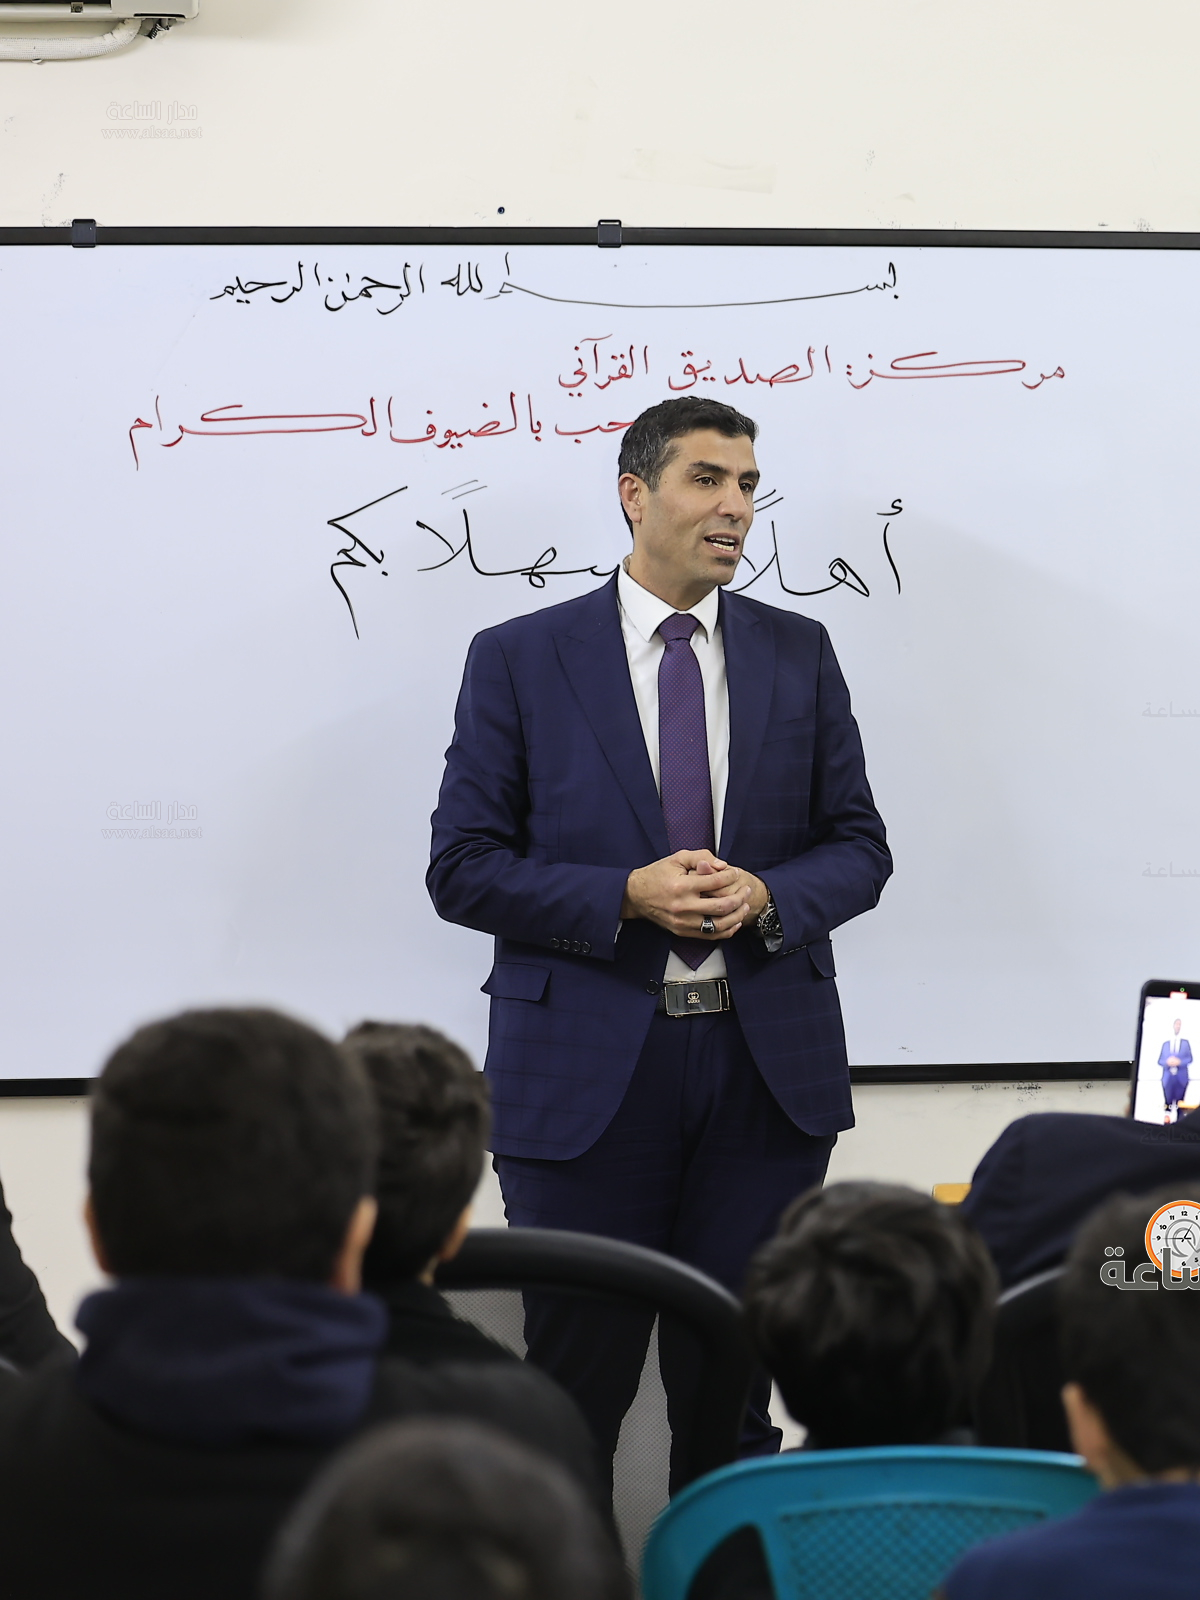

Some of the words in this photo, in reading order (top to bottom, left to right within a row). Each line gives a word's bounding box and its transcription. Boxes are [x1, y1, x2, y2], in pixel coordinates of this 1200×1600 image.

[210, 261, 321, 304] الرحيم
[325, 262, 425, 315] الرحمن
[441, 252, 510, 296] الله
[484, 261, 899, 308] بسم
[558, 333, 649, 398] القرآني
[667, 345, 832, 391] الصديق
[128, 394, 393, 471] الكرام
[390, 391, 541, 449] بالضيوف
[555, 420, 635, 443] حب
[327, 485, 408, 640] بكم
